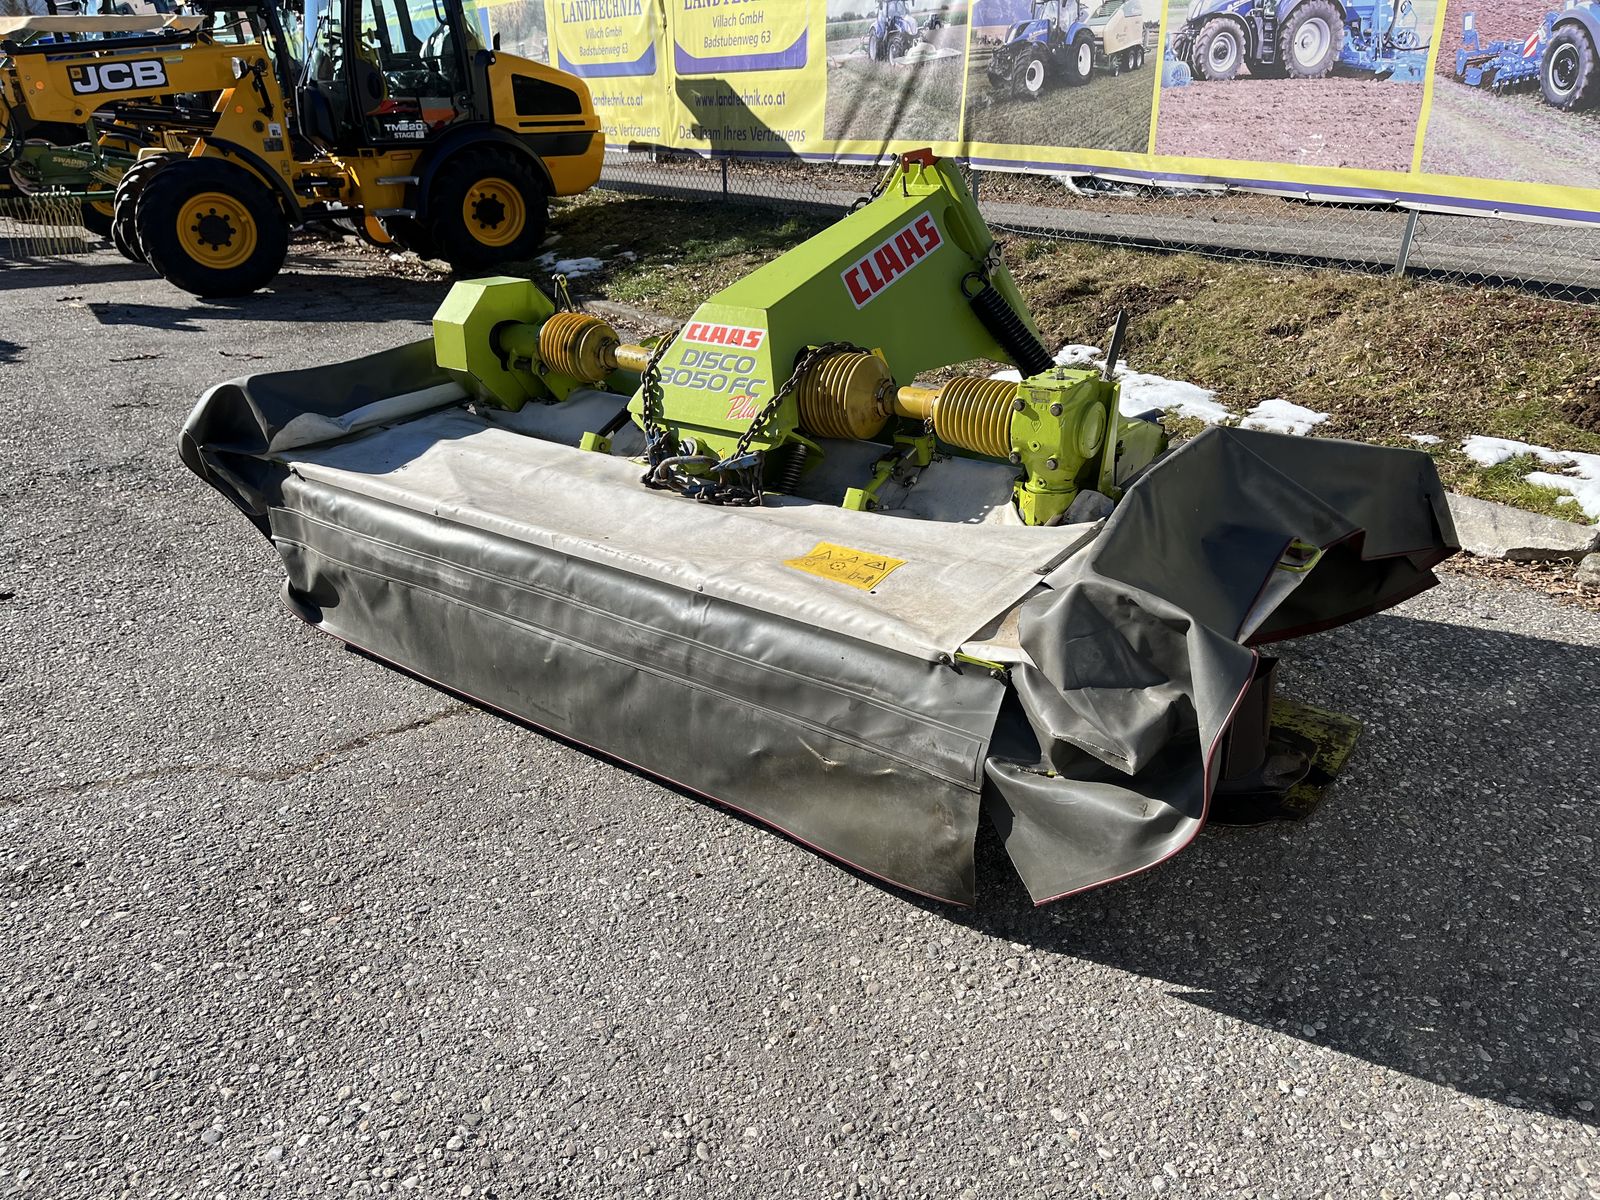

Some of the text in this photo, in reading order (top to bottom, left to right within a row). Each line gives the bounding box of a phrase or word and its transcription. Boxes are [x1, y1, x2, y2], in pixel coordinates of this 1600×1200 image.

[561, 0, 642, 23] LANDTECHNIK
[712, 11, 764, 28] Villach GmbH
[585, 26, 622, 40] Villach GmbH
[704, 30, 772, 48] Badstubenweg 63
[580, 43, 628, 58] Badstubenweg 63
[73, 60, 166, 93] JCB
[592, 90, 643, 106] landtechnik.co.at
[695, 88, 786, 107] www.landtechnik.co.at
[618, 123, 661, 138] Vertrauens
[680, 125, 806, 142] Das Team Ihres Vertrauens
[844, 215, 941, 305] CLAAS
[685, 323, 763, 349] CLAAS
[679, 348, 757, 374] DISCO
[659, 366, 767, 398] 3050 FC
[725, 395, 759, 419] Plus
